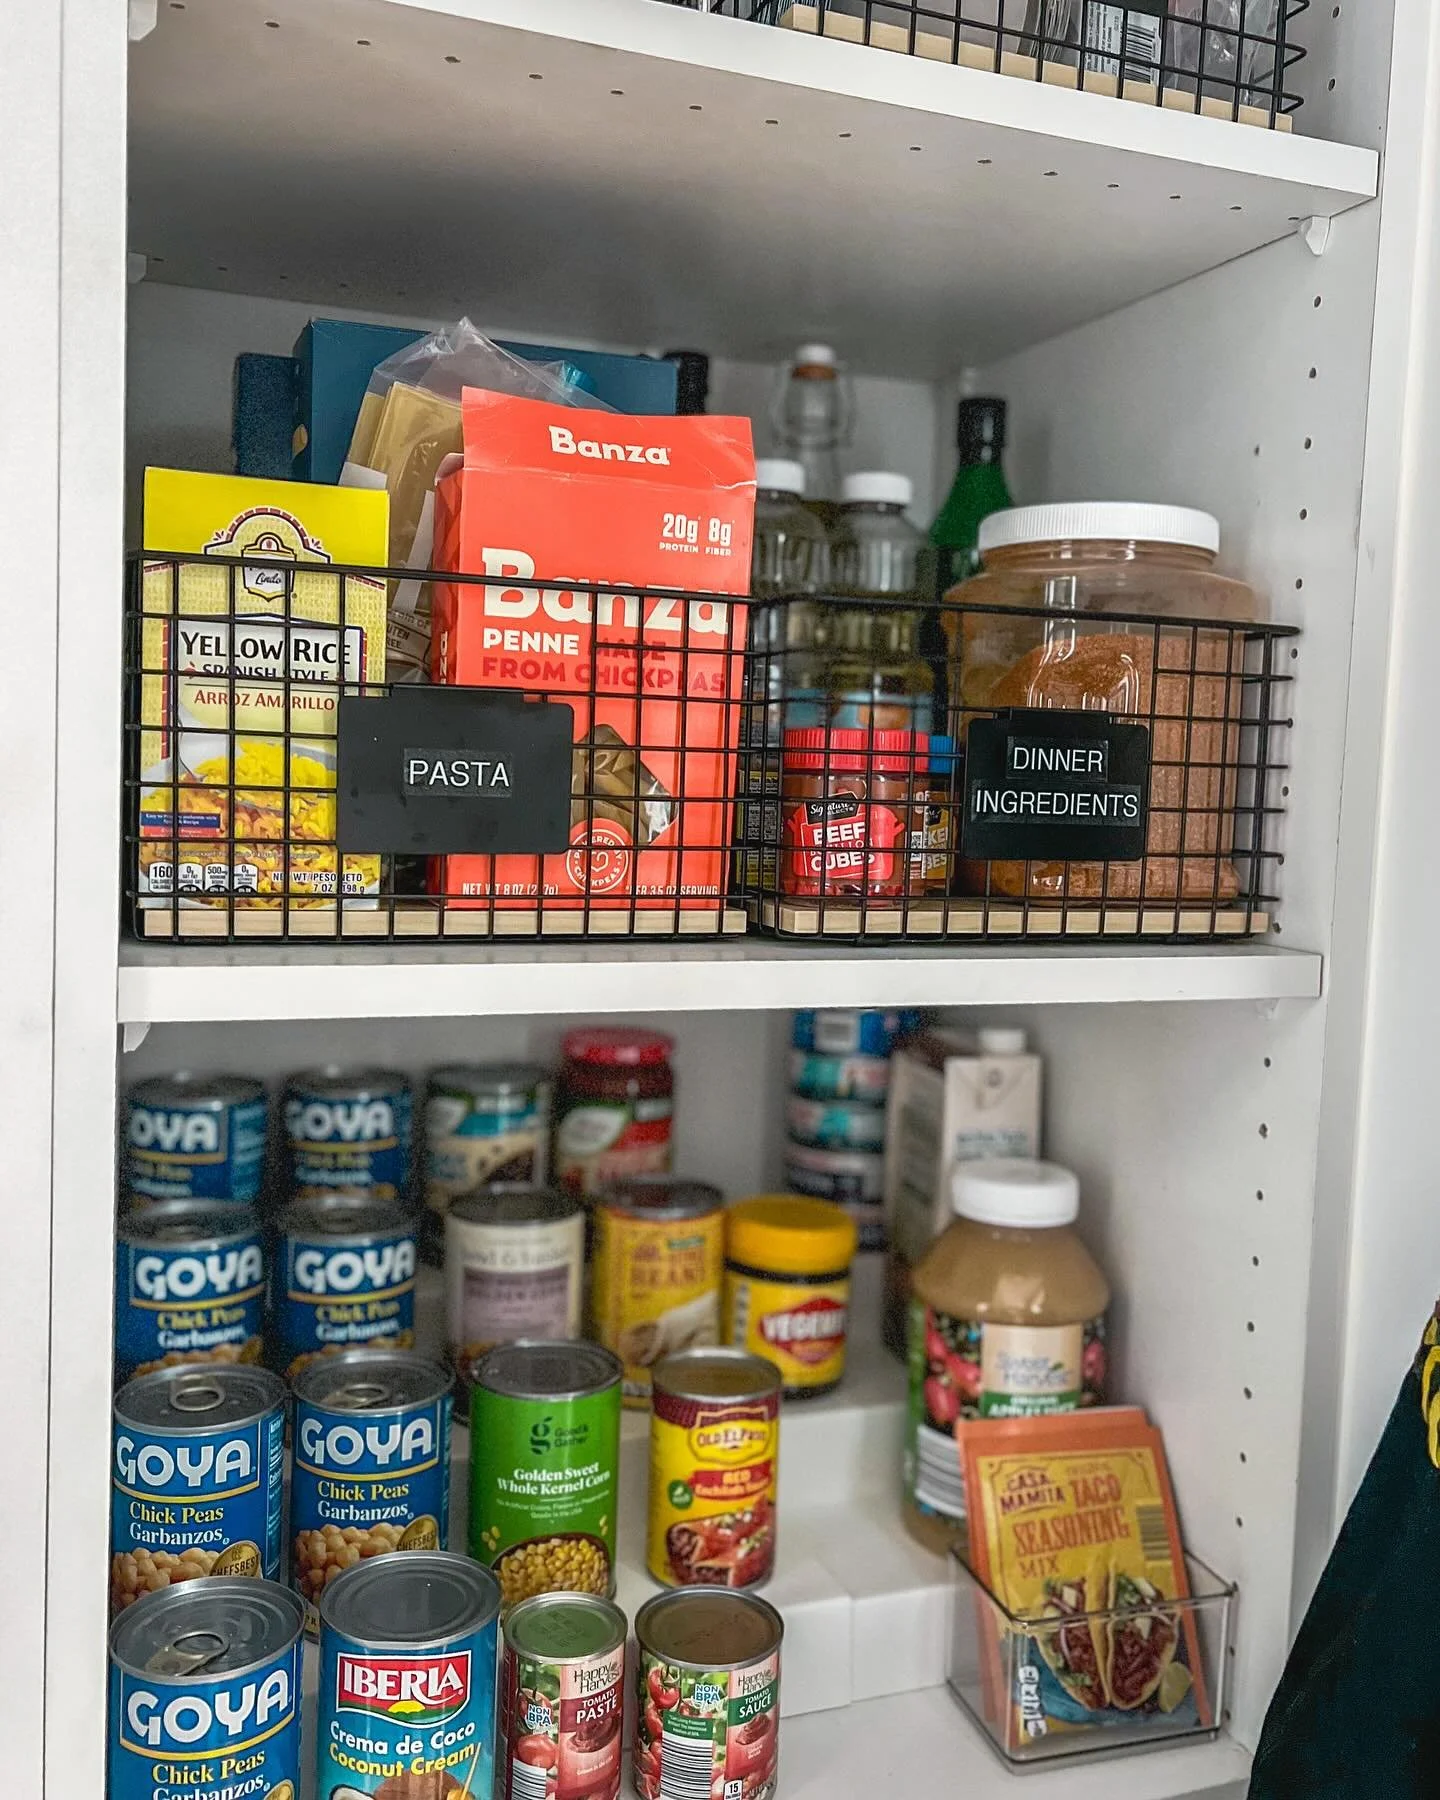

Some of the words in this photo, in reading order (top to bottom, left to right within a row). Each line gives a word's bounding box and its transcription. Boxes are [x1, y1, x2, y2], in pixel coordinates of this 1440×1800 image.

[549, 425, 670, 466] Banza
[662, 513, 698, 543] 20g
[708, 517, 732, 546] 8g
[659, 542, 699, 553] PROTEIN
[705, 547, 732, 556] FIBER
[482, 547, 730, 635] Banza
[180, 631, 284, 661] YELLOW
[293, 638, 351, 664] RICE
[483, 628, 579, 656] PENNE
[284, 667, 329, 681] TYLE
[482, 656, 566, 682] FROM
[574, 664, 726, 692] CHICKPAS
[194, 690, 250, 706] ARROZ
[1013, 747, 1103, 772] DINNER
[408, 760, 510, 787] PASTA
[975, 790, 1138, 817] INGREDIENTS
[813, 822, 866, 845] BEEF
[152, 866, 173, 878] 160
[810, 851, 876, 872] CUBES
[321, 884, 333, 893] OZ
[462, 882, 481, 896] NET
[135, 1244, 263, 1300] GOYA
[294, 1239, 416, 1294] GOYA
[301, 1417, 432, 1466] GOYA
[116, 1435, 251, 1487] GOYA
[513, 1468, 565, 1482] Golden
[564, 1462, 600, 1480] Sweet
[317, 1480, 366, 1501] Chick
[370, 1483, 409, 1500] Peas
[497, 1477, 538, 1495] Whole
[539, 1477, 584, 1495] Kernel
[585, 1470, 611, 1488] Corn
[1007, 1471, 1050, 1491] CASA
[1068, 1473, 1121, 1508] TACO
[129, 1501, 176, 1524] Chick
[181, 1506, 224, 1524] Peas
[317, 1500, 408, 1521] Garbanzos
[1000, 1487, 1066, 1515] MAMITA
[129, 1522, 223, 1546] Garbanzos
[1012, 1505, 1131, 1558] SEASONING
[1018, 1556, 1060, 1580] MIX
[343, 1660, 465, 1704] IBERIA
[574, 1662, 612, 1683] Happy
[582, 1688, 615, 1708] TOMATO
[694, 1685, 719, 1693] NON
[694, 1692, 720, 1701] BPA
[744, 1688, 770, 1705] TOMATO
[127, 1669, 288, 1745] GOYA
[528, 1704, 550, 1714] NON
[528, 1712, 551, 1724] BPA
[576, 1695, 617, 1724] PASTE
[739, 1693, 772, 1718] SAUCE
[330, 1720, 388, 1755] Crema
[395, 1735, 424, 1755] de
[430, 1722, 476, 1750] Coco
[152, 1764, 214, 1785] Chick
[220, 1750, 266, 1780] Peas
[329, 1742, 404, 1777] Coconut
[410, 1743, 475, 1775] Cream
[729, 1783, 739, 1793] 15
